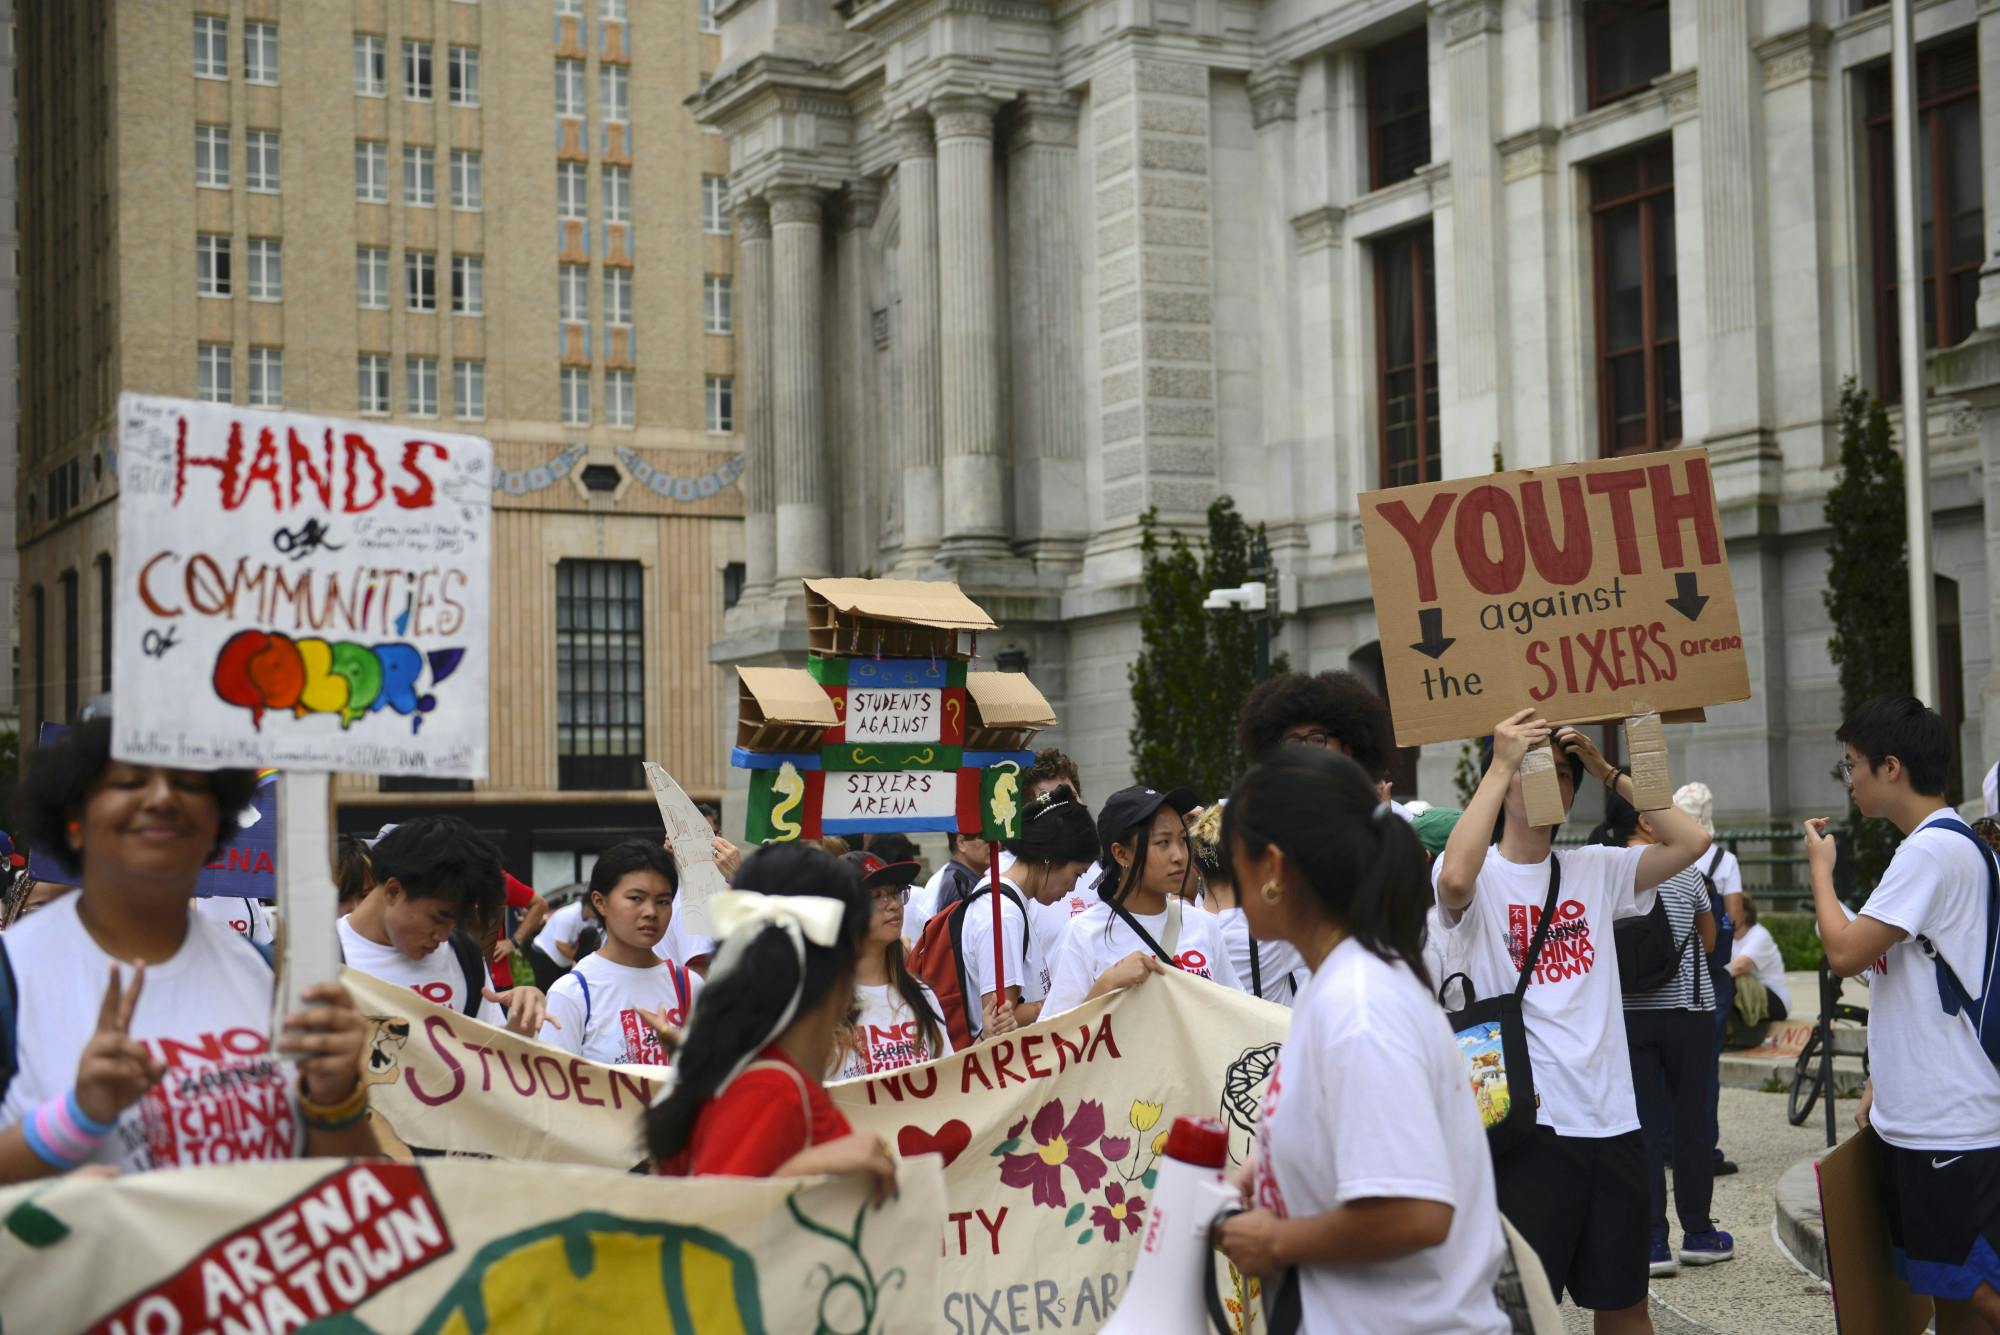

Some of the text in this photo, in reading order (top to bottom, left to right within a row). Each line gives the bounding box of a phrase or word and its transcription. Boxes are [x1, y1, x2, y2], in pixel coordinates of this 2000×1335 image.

[173, 416, 448, 513] HANDS
[1376, 458, 1721, 602] YOUTH
[1480, 577, 1626, 634] against
[1420, 622, 1742, 702] the SIXERS arena
[854, 692, 931, 713] STUDENTS
[856, 716, 928, 735] AGAINST
[847, 774, 932, 793] SIXERS
[851, 797, 918, 815] ARENA
[158, 1027, 270, 1067] NO
[961, 1014, 1121, 1093] ARENA
[1781, 1026, 1811, 1046] NO
[201, 1168, 393, 1319] ARENA
